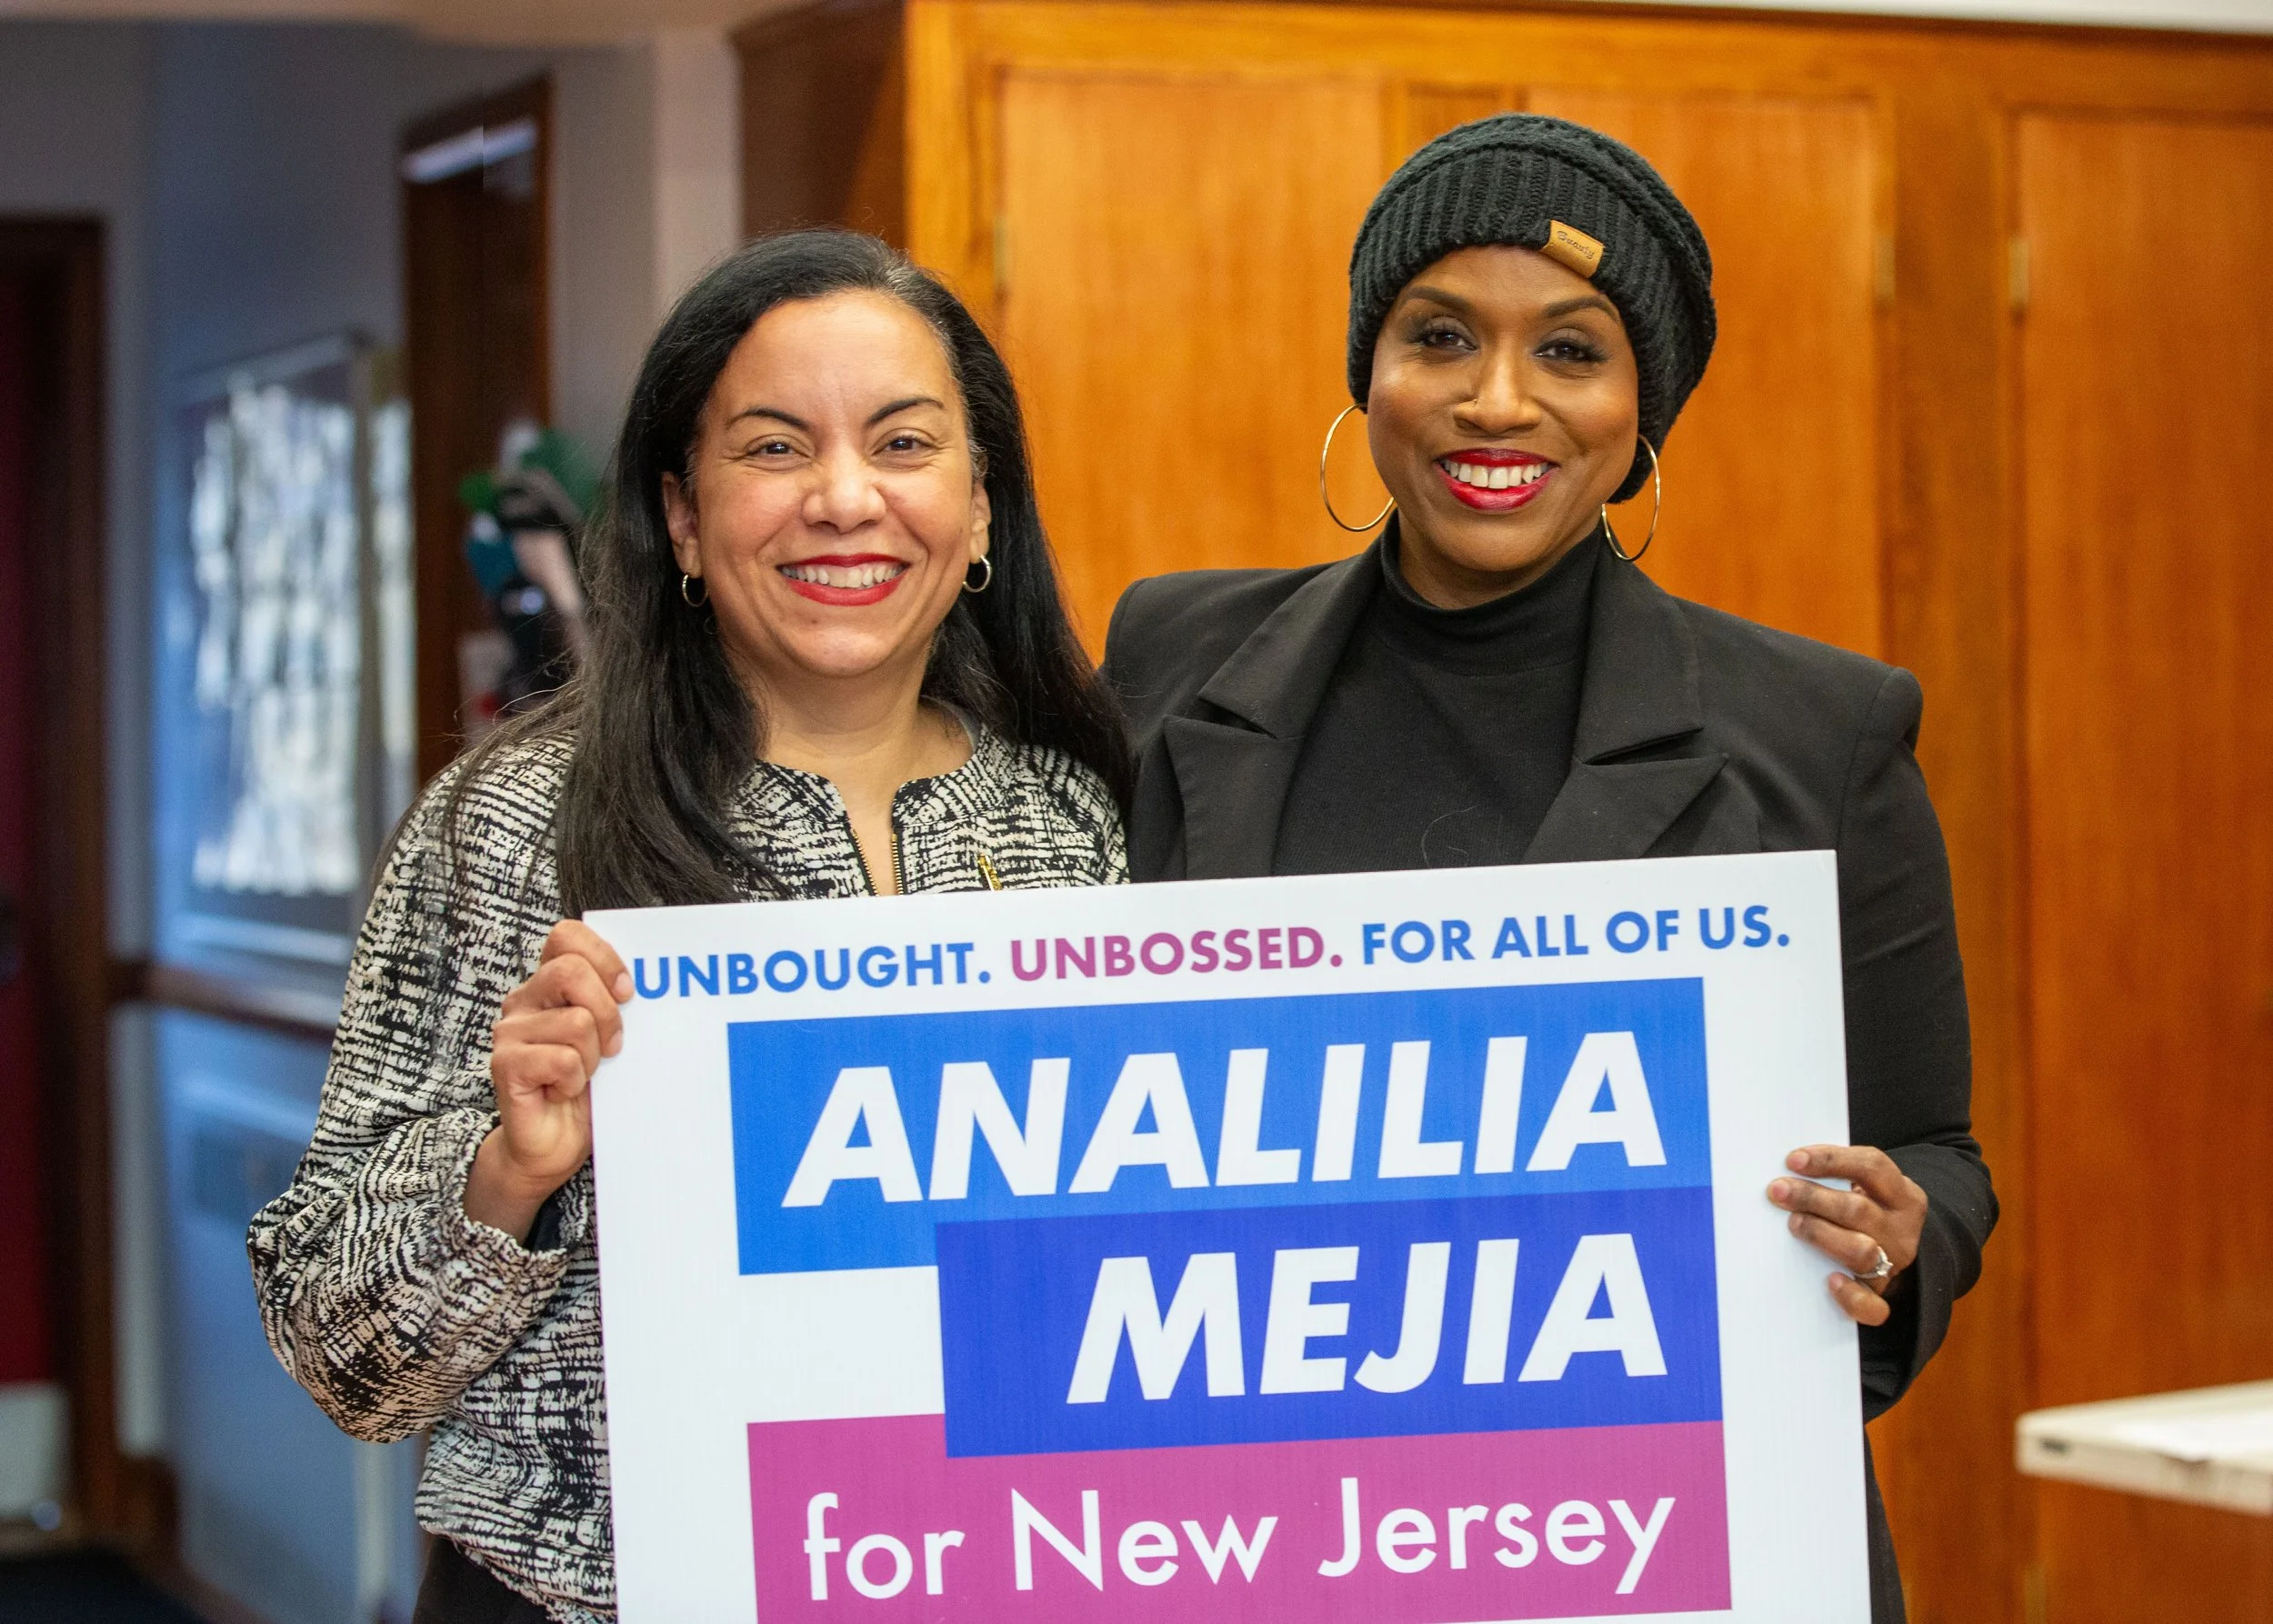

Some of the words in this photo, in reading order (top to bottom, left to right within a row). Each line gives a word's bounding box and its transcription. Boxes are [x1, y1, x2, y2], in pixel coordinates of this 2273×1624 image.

[634, 942, 991, 1000] UNBOUGHT.
[1012, 927, 1342, 981] UNBOSSED.
[1361, 918, 1475, 966] FOR
[1491, 913, 1589, 960] ALL
[1605, 908, 1680, 955] OF
[1698, 904, 1790, 950] US.
[781, 1031, 1667, 1208] ANALILIA
[1066, 1234, 1667, 1404] MEJIA
[804, 1492, 965, 1600] for
[1012, 1489, 1277, 1591] New
[1318, 1478, 1676, 1594] Jersey
